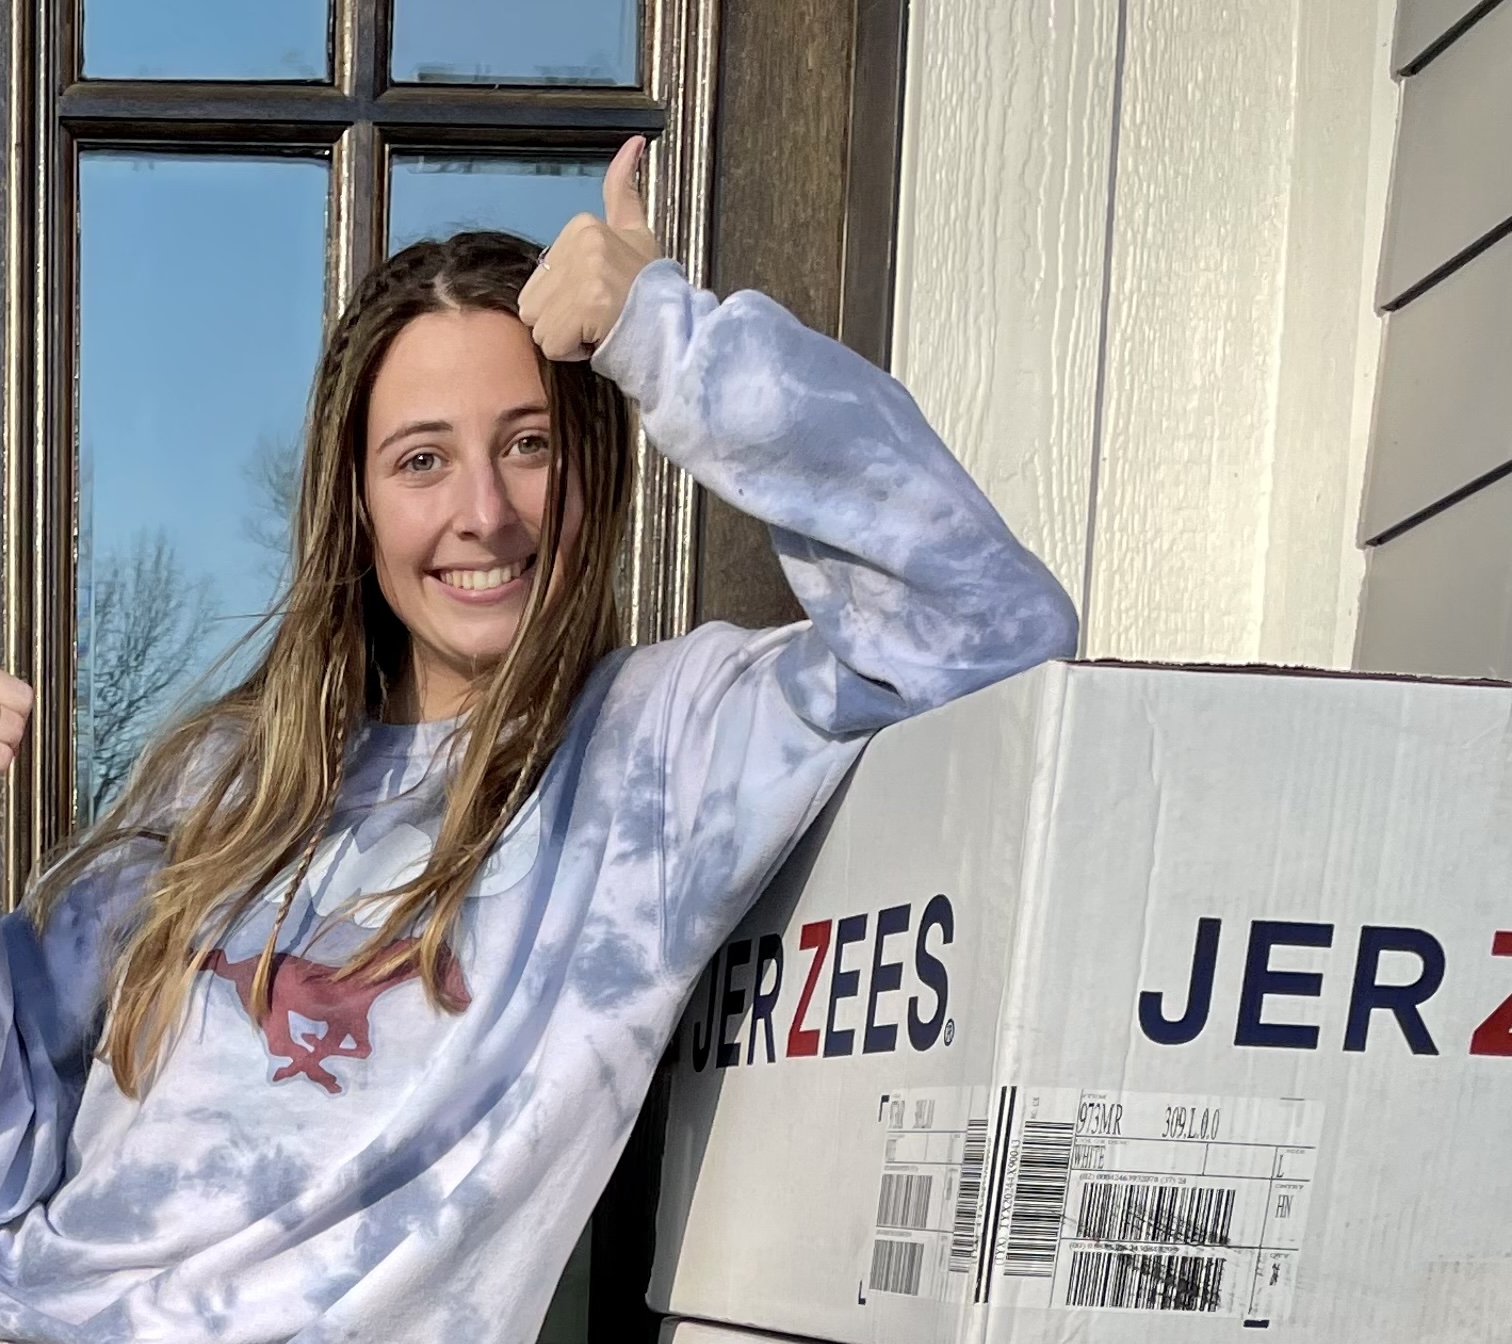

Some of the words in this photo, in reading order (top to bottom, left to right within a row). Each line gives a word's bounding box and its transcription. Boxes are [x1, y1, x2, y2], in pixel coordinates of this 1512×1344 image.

[692, 893, 954, 1073] JERZEES
[1076, 1102, 1123, 1135] 973MR
[1074, 1145, 1106, 1169] WHITE
[1276, 1154, 1285, 1178] L
